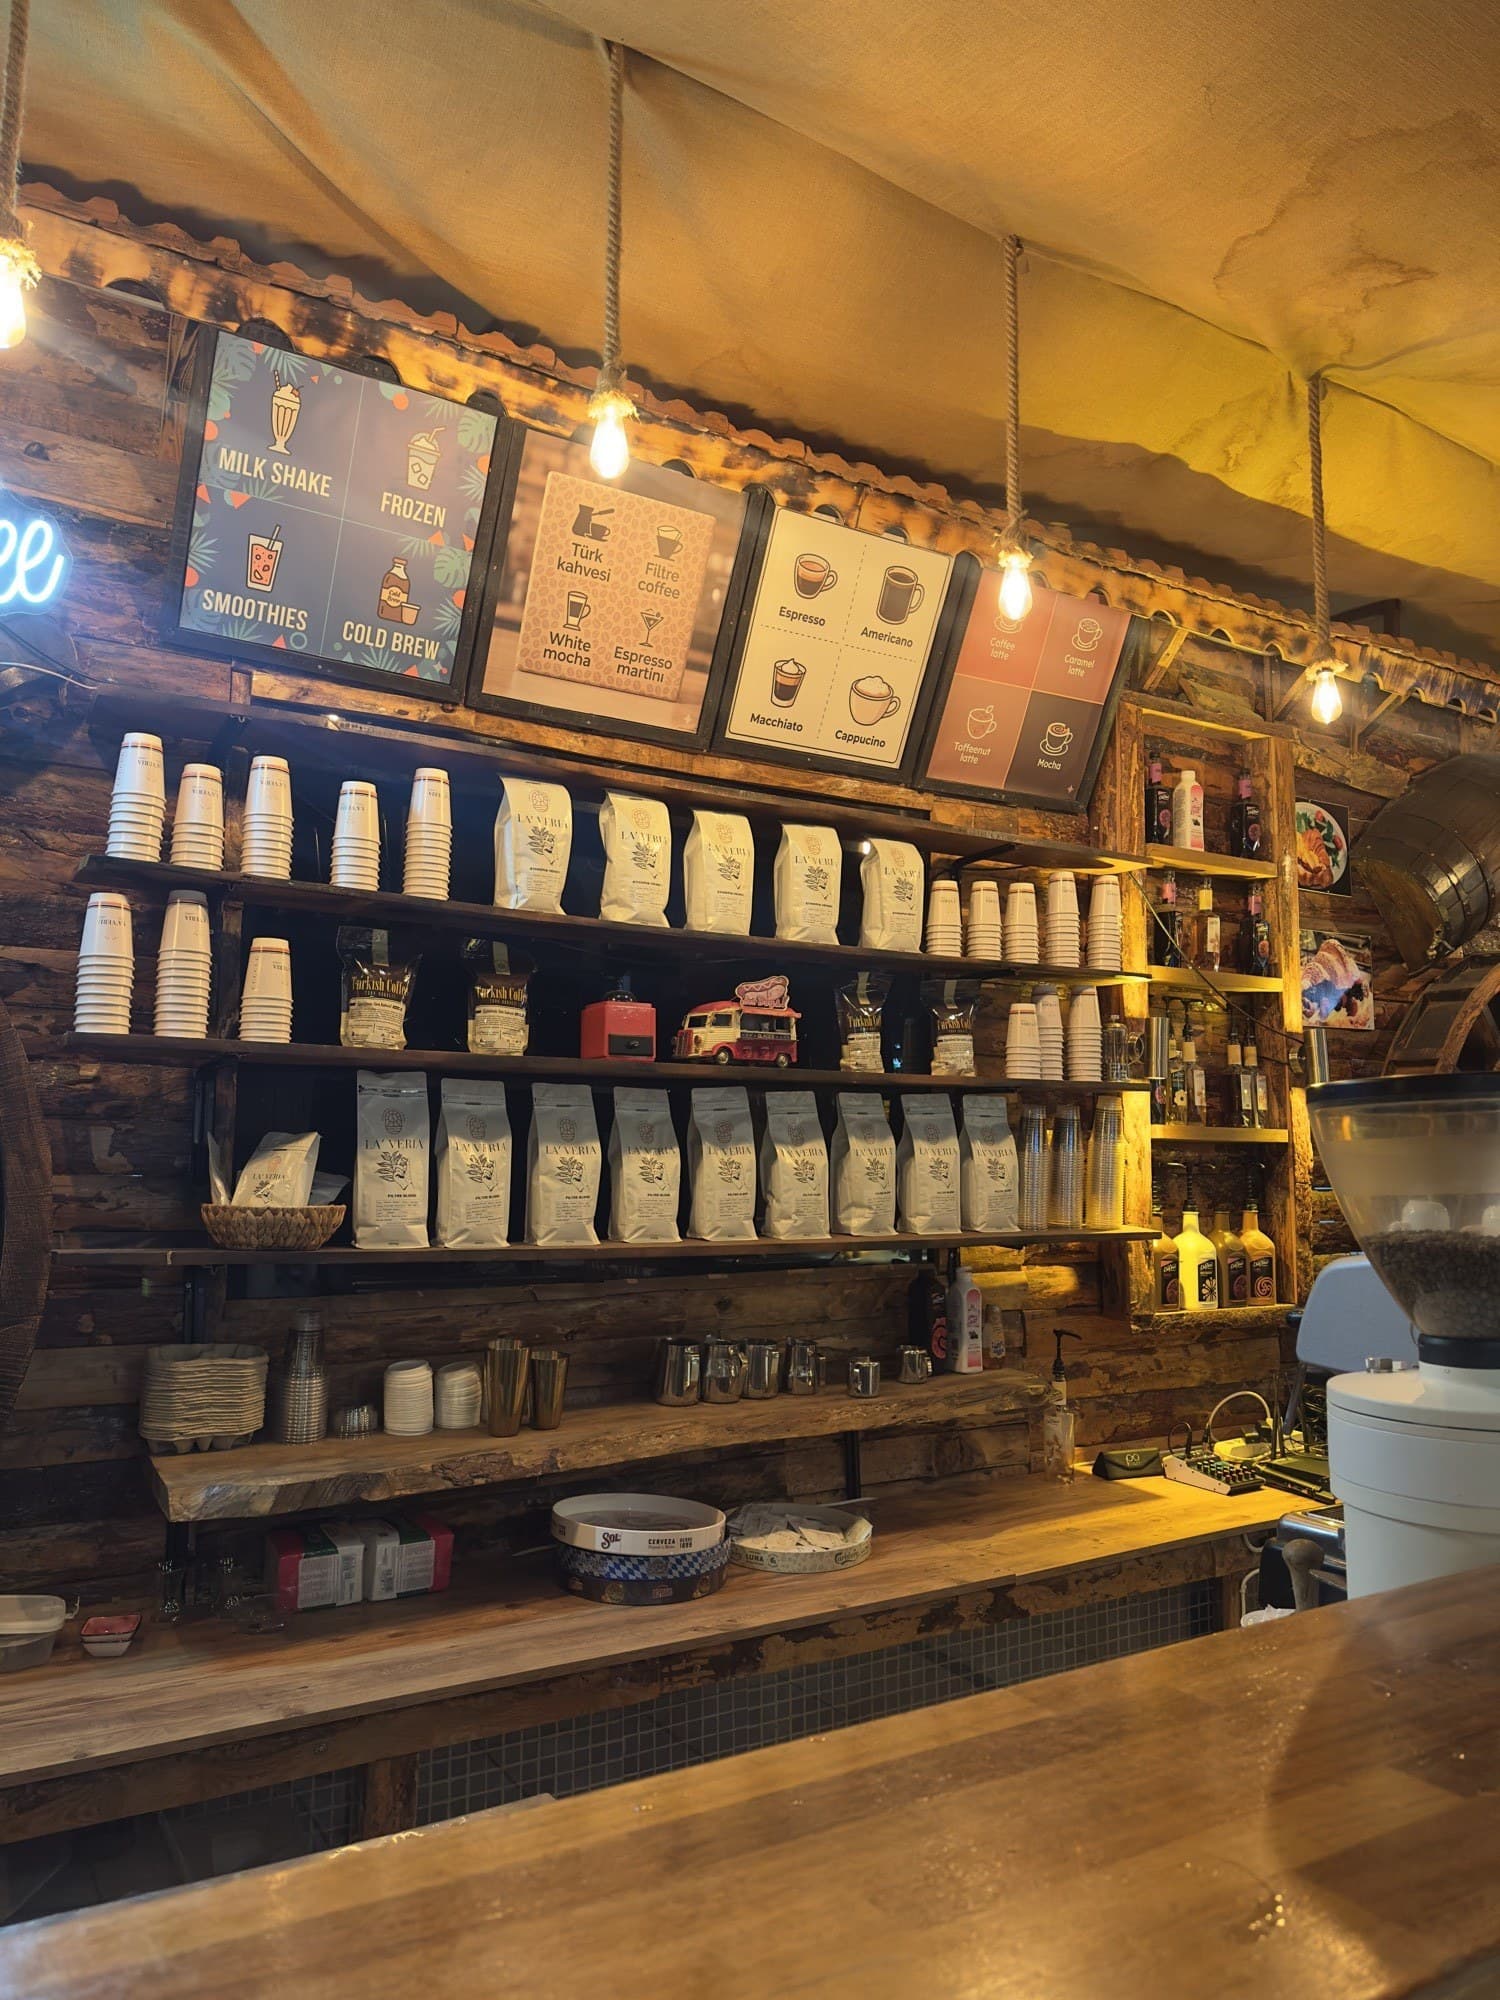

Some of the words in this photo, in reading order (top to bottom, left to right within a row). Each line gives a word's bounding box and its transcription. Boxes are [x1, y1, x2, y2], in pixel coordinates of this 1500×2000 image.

[219, 447, 266, 481] MILK
[271, 462, 333, 498] SHAKE
[380, 492, 447, 528] FROZEN
[571, 542, 604, 564] Türk
[556, 556, 612, 582] kahvesi
[644, 561, 680, 583] Filtre
[637, 578, 681, 600] coffee
[202, 589, 308, 632] SMOOTHIES
[778, 605, 826, 628] Espresso
[342, 620, 387, 650] COLD
[390, 633, 441, 661] BREW
[549, 631, 592, 653] White
[860, 626, 914, 648] Americano
[543, 646, 592, 668] mocha
[613, 646, 673, 671] Espresso
[989, 649, 1010, 661] latte
[1064, 654, 1095, 669] Caramel
[616, 662, 665, 683] martini
[1067, 665, 1086, 678] latte
[750, 713, 804, 733] Macchiato
[834, 730, 887, 750] Cappucino
[953, 741, 992, 756] Toffeenut
[960, 752, 980, 765] latte
[1036, 758, 1062, 771] Mocha
